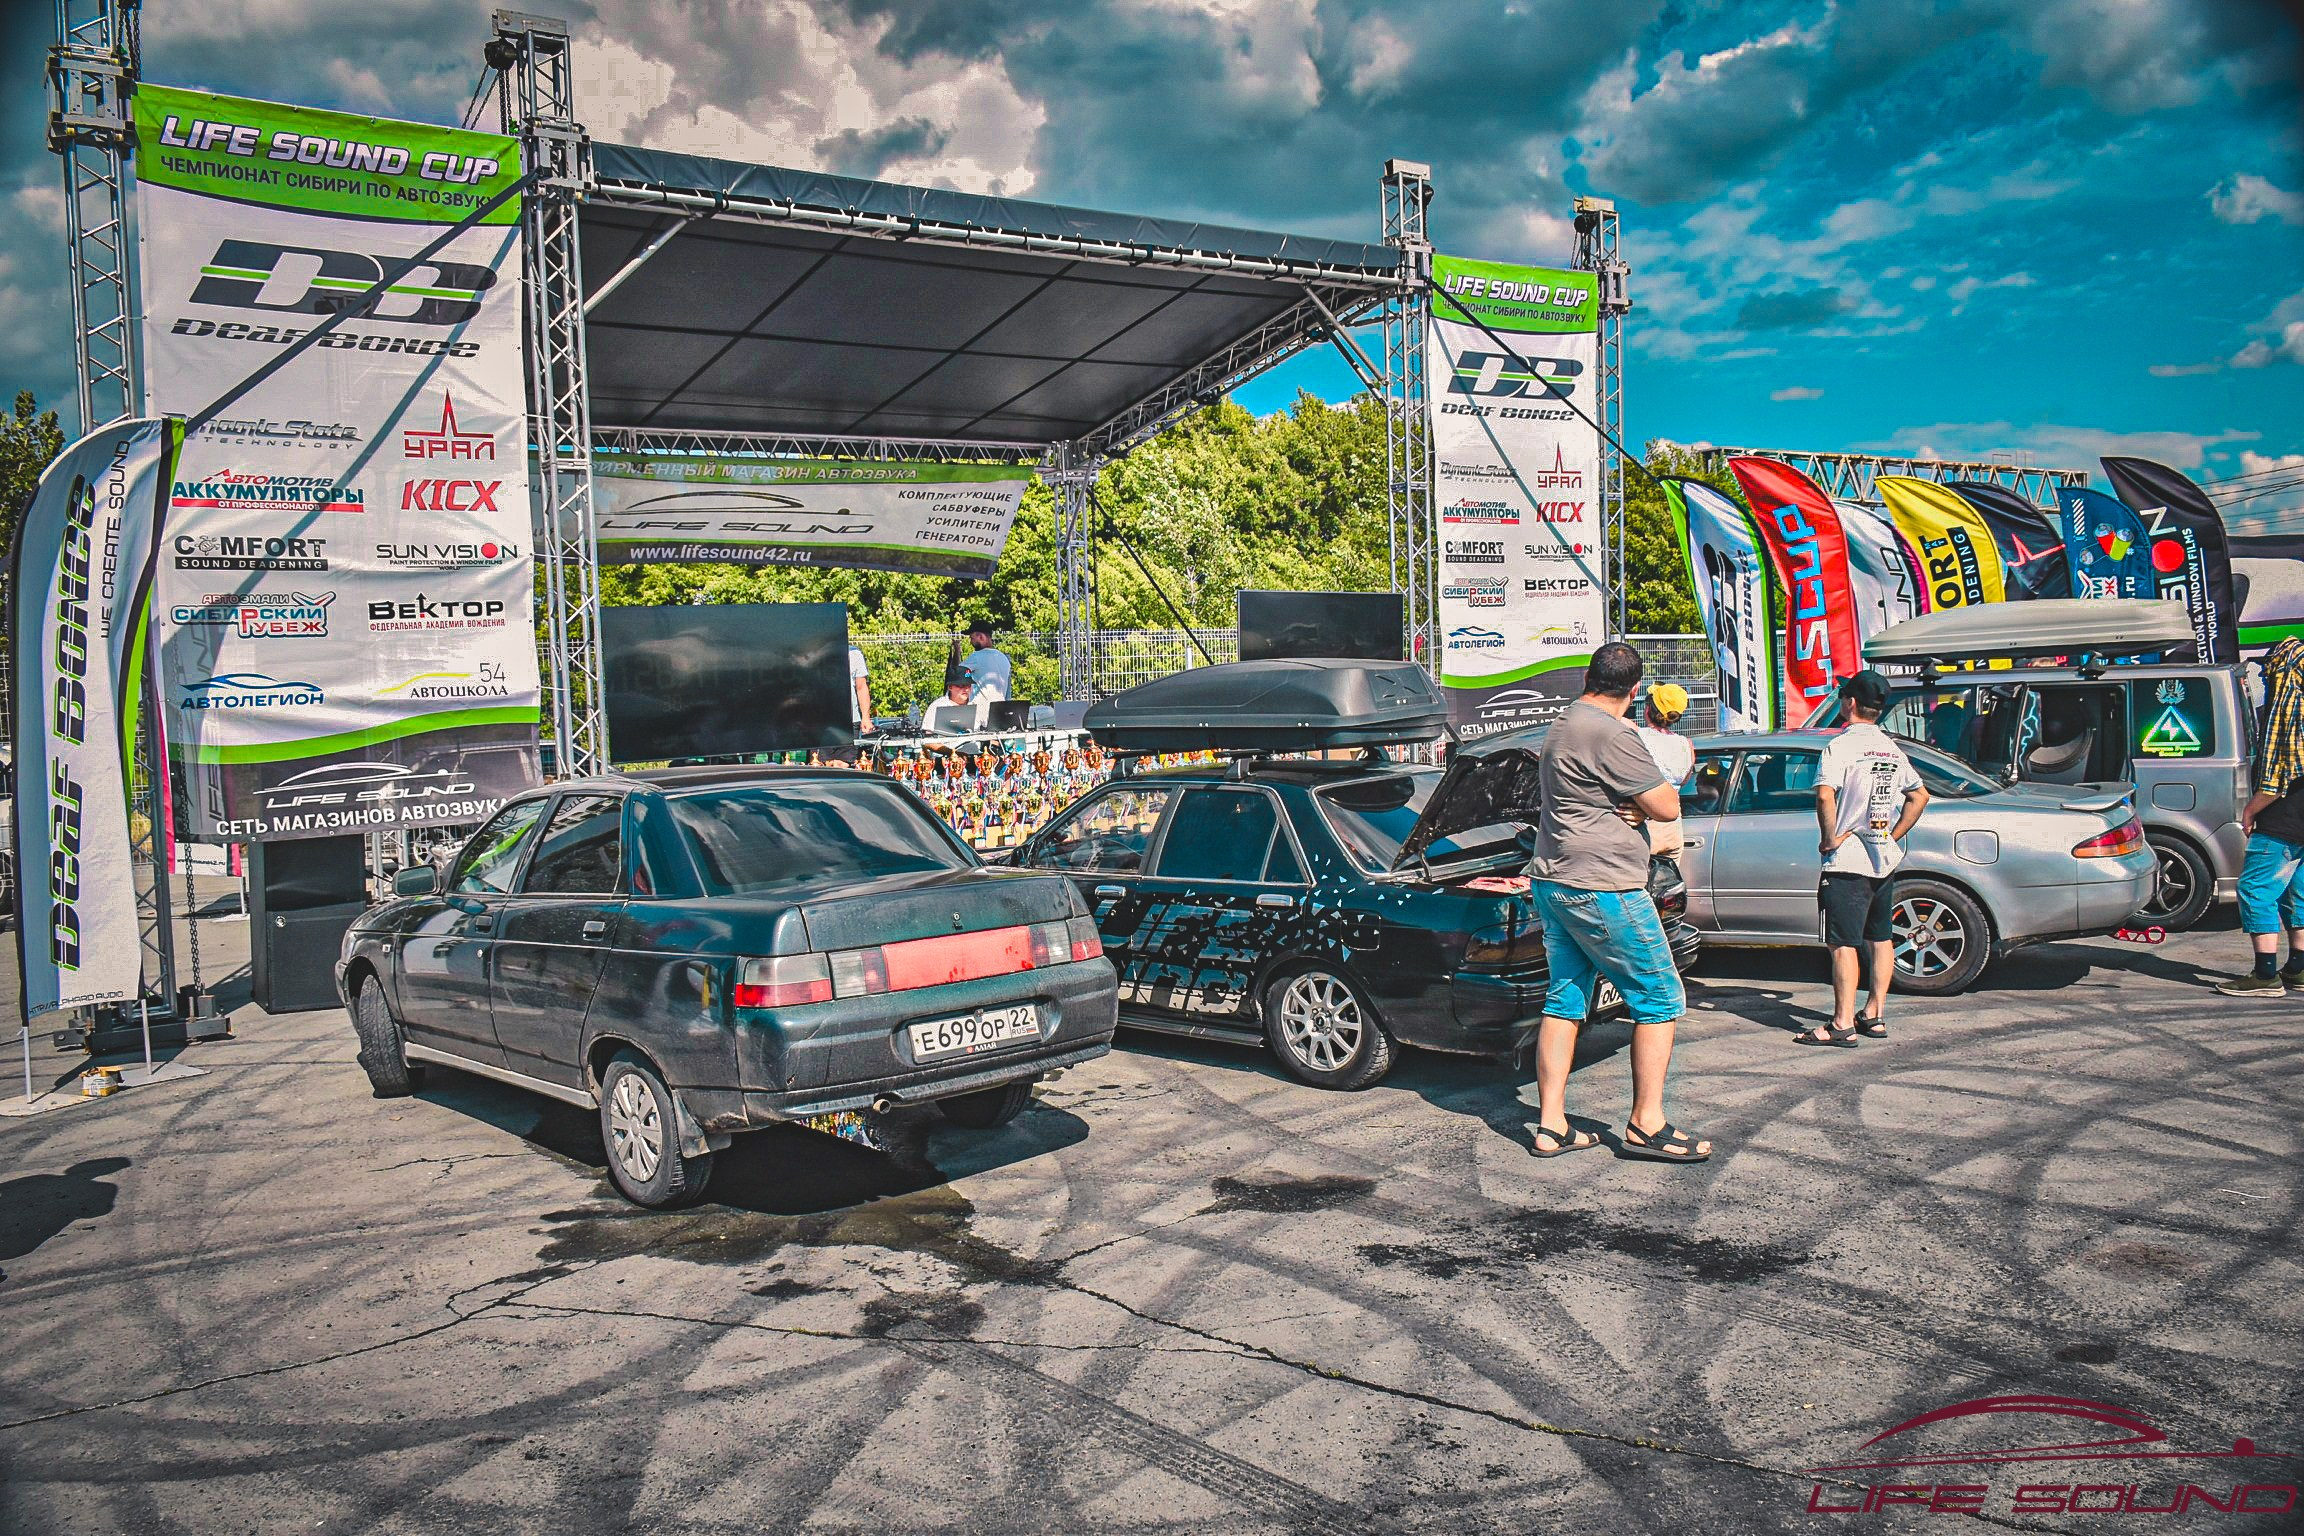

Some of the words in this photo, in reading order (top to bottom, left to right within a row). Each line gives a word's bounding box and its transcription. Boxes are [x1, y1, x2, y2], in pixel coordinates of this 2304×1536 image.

[159, 115, 260, 157] LIFE
[268, 130, 409, 177] SOUND
[418, 151, 500, 185] CUP
[160, 156, 281, 185] ЧЕМПИОНАТ
[286, 174, 363, 197] СИБИРИ
[366, 182, 392, 198] ПО
[1443, 273, 1487, 298] LIFE
[1488, 280, 1550, 305] SOUND
[1552, 287, 1588, 308] CUP
[1493, 306, 1526, 318] СИБИРИ
[1527, 311, 1539, 319] ПО
[1540, 311, 1586, 324] АВТОЗВУКУ
[204, 436, 354, 450] TECHNOLOGY
[403, 438, 497, 461] УРАЛ
[110, 440, 131, 510] SOUND
[721, 464, 810, 480] МАГАЗИН
[815, 467, 918, 481] АВТОЗВУКА
[1537, 476, 1582, 489] УРАЛ
[172, 481, 364, 504] АККУМУЛЯТОРЫ
[400, 479, 503, 512] KICX
[898, 490, 1013, 503] КОМПЛЕКТУЮЩИЕ
[218, 501, 230, 510] ОТ
[231, 502, 321, 511] ПРОФЕССИОНАЛОВ
[932, 504, 1006, 517] САБВУФЕРЫ
[1443, 506, 1520, 519] АККУМУЛЯТОРЫ
[1536, 501, 1586, 523] KICX
[600, 520, 709, 532] LIFE
[718, 520, 875, 535] SOUND
[926, 517, 1001, 532] УСИЛИТЕЛИ
[915, 530, 995, 548] ГЕНЕРАТОРЫ
[2181, 527, 2194, 561] FILMS
[376, 545, 427, 559] SUN
[630, 544, 811, 562] www.lifesound42.ru
[1525, 544, 1550, 555] SUN
[101, 517, 122, 601] CREATE
[181, 559, 232, 568] SOUND
[238, 560, 323, 569] DEADENING
[1447, 555, 1468, 563] SOUND
[1524, 578, 1589, 590] ВЕКТОР
[2189, 562, 2203, 614] WINDOW
[202, 594, 289, 605] АВТОЭМАЛИ
[367, 599, 505, 621] ВЕКТОР
[100, 606, 113, 639] WE
[370, 621, 423, 632] ФЕДЕРАЛЬНАЯ
[426, 620, 464, 630] АКАДЕМИЯ
[467, 618, 506, 628] ВОЖДЕНИЯ
[1573, 622, 1588, 635] 54
[2206, 601, 2218, 639] WORLD
[1448, 639, 1505, 649] АВТОЛЕГИОН
[1541, 637, 1588, 645] АВТОШКОЛА
[2197, 625, 2209, 666] ECTION
[479, 662, 507, 684] 54
[410, 684, 508, 699] АВТОШКОЛА
[180, 692, 324, 710] АВТОЛЕГИОН
[1481, 708, 1517, 718] LIFE
[1460, 724, 1483, 735] СЕТЬ
[266, 791, 348, 809] LIFE
[355, 783, 476, 802] SOUND
[216, 818, 268, 836] СЕТЬ
[273, 808, 396, 832] МАГАЗИНОВ
[1009, 1007, 1030, 1029] 22
[1011, 1027, 1027, 1036] RUS
